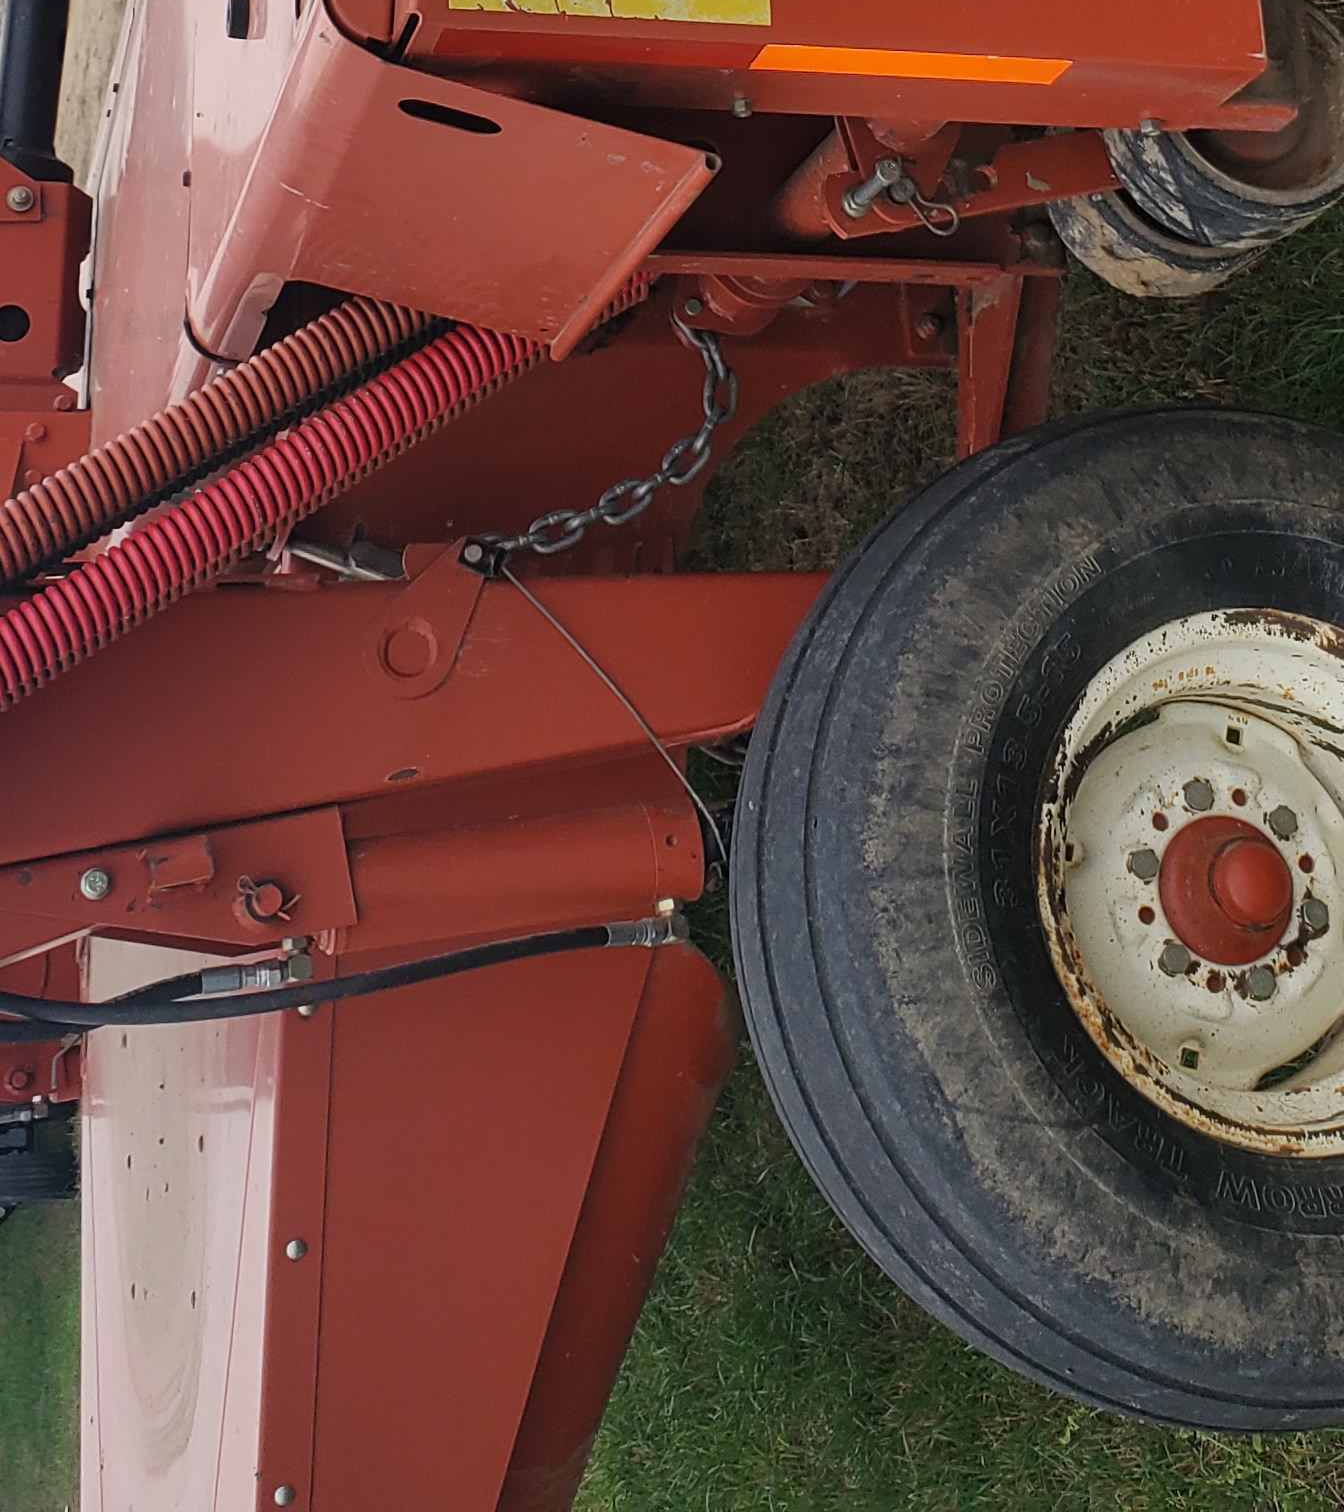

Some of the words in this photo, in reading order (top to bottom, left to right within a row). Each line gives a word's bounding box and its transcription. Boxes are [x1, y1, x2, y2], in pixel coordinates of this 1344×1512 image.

[962, 550, 1104, 754] PROTECTION
[951, 775, 999, 991] SIDEWALL
[1046, 1031, 1194, 1182] TRACK
